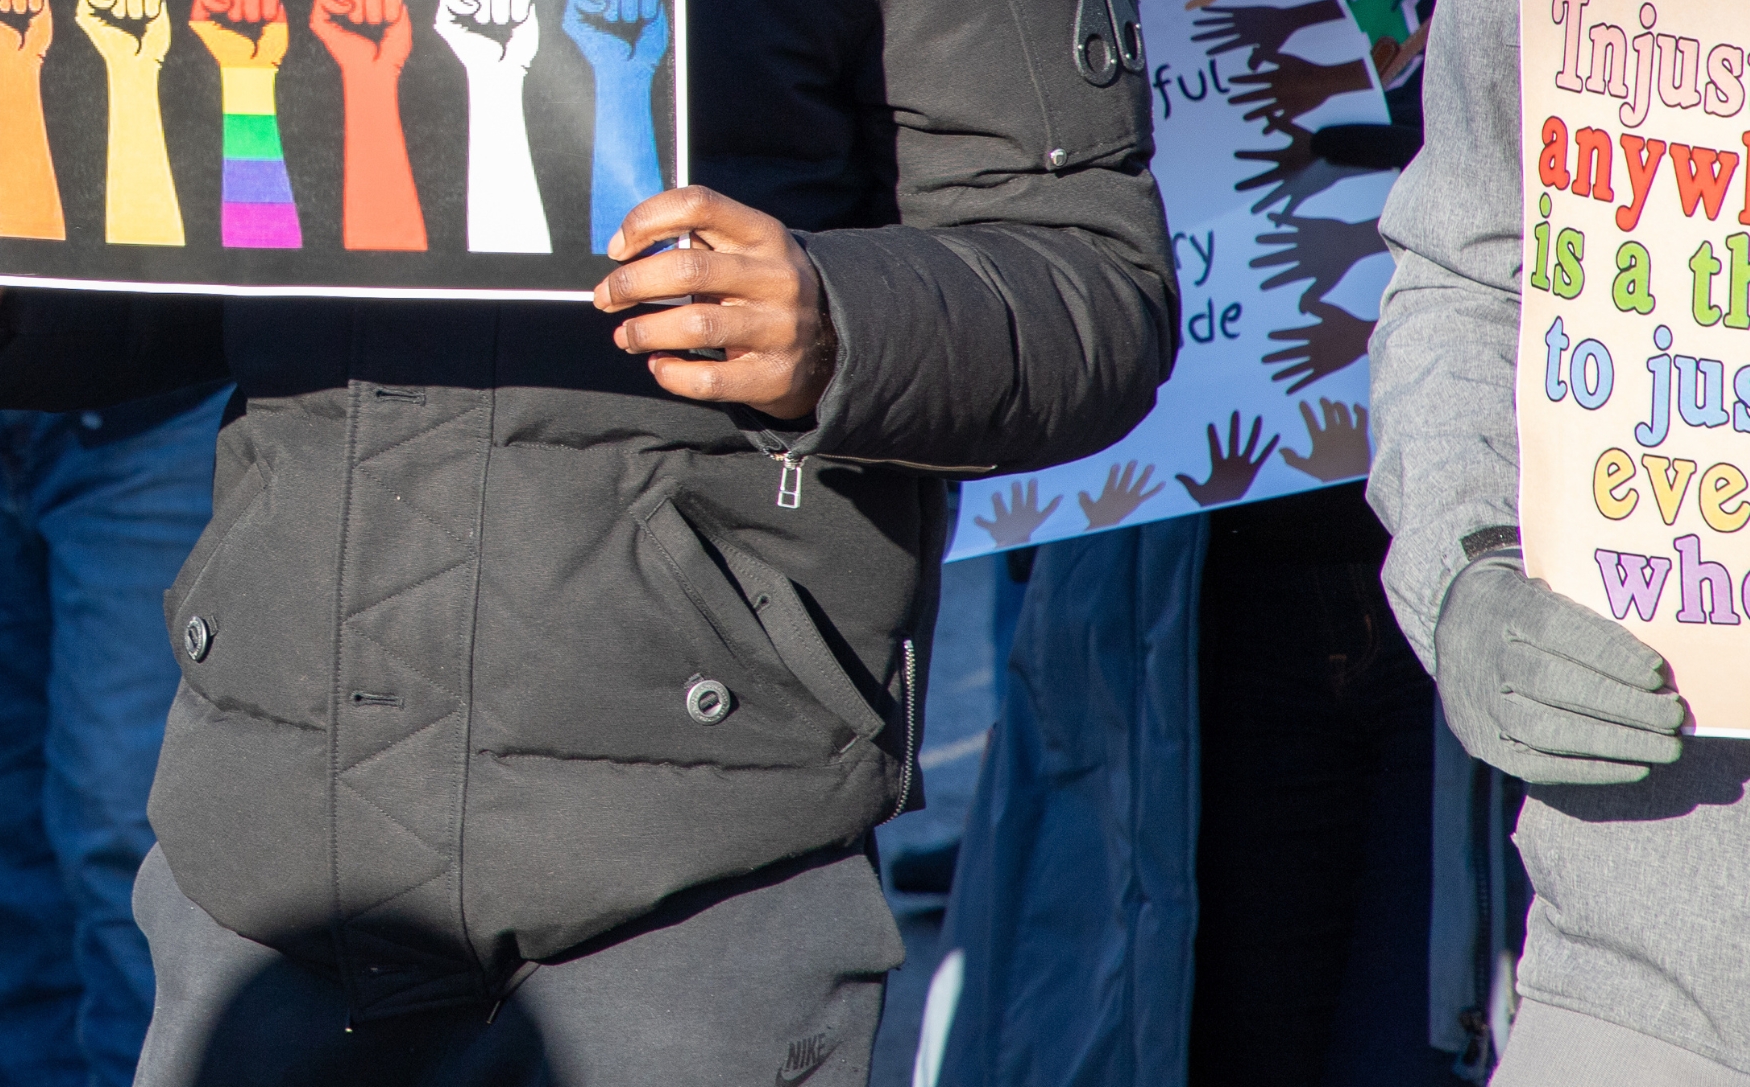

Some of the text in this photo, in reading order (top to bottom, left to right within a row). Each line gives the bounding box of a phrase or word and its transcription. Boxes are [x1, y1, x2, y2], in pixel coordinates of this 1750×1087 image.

[1153, 56, 1231, 119] ful
[1538, 115, 1750, 232] anyw
[1531, 192, 1586, 301] is
[1612, 240, 1656, 316] a
[1179, 297, 1243, 350] de
[1545, 315, 1615, 411] to
[1592, 447, 1750, 533] eve
[1594, 534, 1750, 626] wh
[785, 1032, 826, 1071] NIKE
